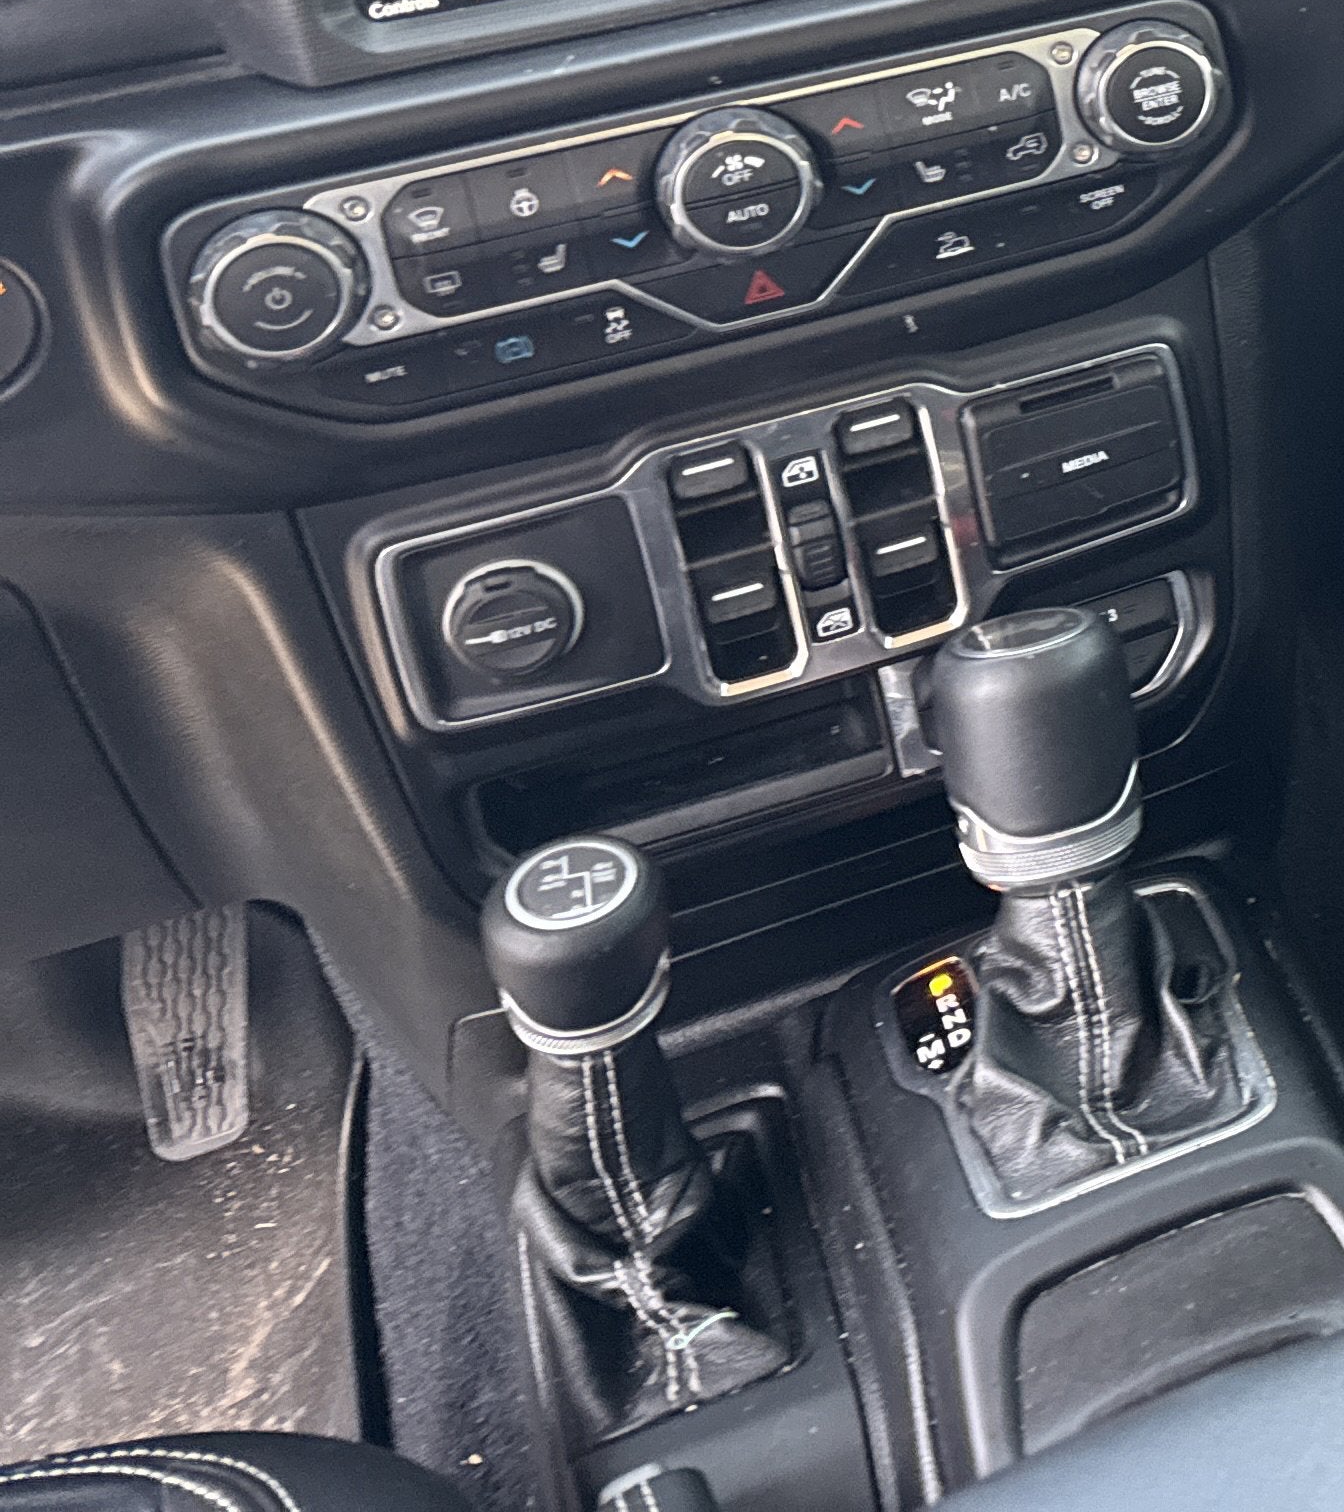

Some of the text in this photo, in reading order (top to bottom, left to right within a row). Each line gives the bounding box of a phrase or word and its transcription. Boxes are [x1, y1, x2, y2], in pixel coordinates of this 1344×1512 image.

[998, 82, 1033, 103] A/C
[1132, 80, 1182, 100] BROWSE
[1141, 94, 1180, 112] ENTER
[721, 169, 754, 187] OFF
[1079, 183, 1126, 204] SCREEN
[1089, 196, 1115, 210] OFF
[725, 202, 770, 225] AUTO
[604, 327, 633, 344] OFF
[364, 364, 409, 385] MUTE
[1061, 449, 1110, 474] MEDIA
[506, 616, 558, 640] 12V DC
[935, 992, 960, 1014] R
[941, 1007, 968, 1031] N
[947, 1027, 972, 1049] D
[916, 1038, 946, 1064] M
